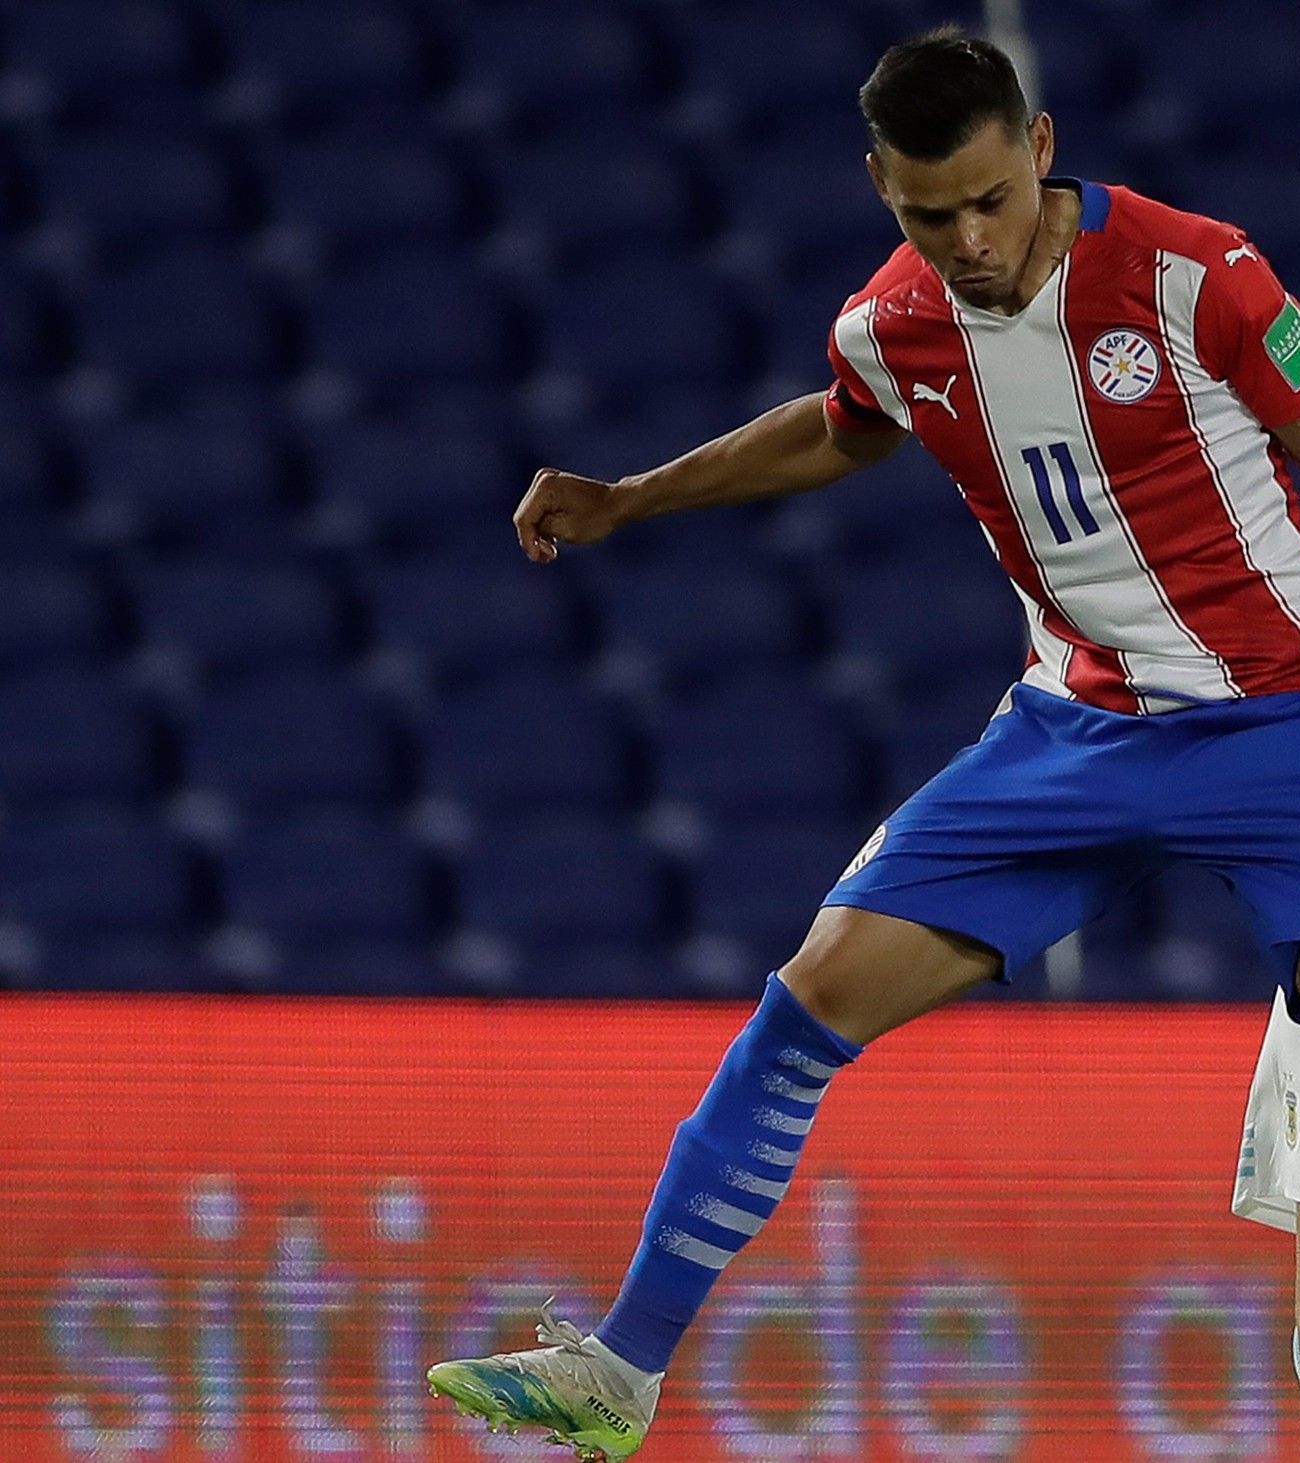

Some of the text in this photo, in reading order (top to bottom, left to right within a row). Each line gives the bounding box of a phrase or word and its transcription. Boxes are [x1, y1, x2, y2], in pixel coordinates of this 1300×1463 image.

[1106, 334, 1127, 349] APF
[1020, 441, 1101, 546] 11
[698, 1168, 1030, 1460] de
[587, 1395, 631, 1434] NEMESIS
